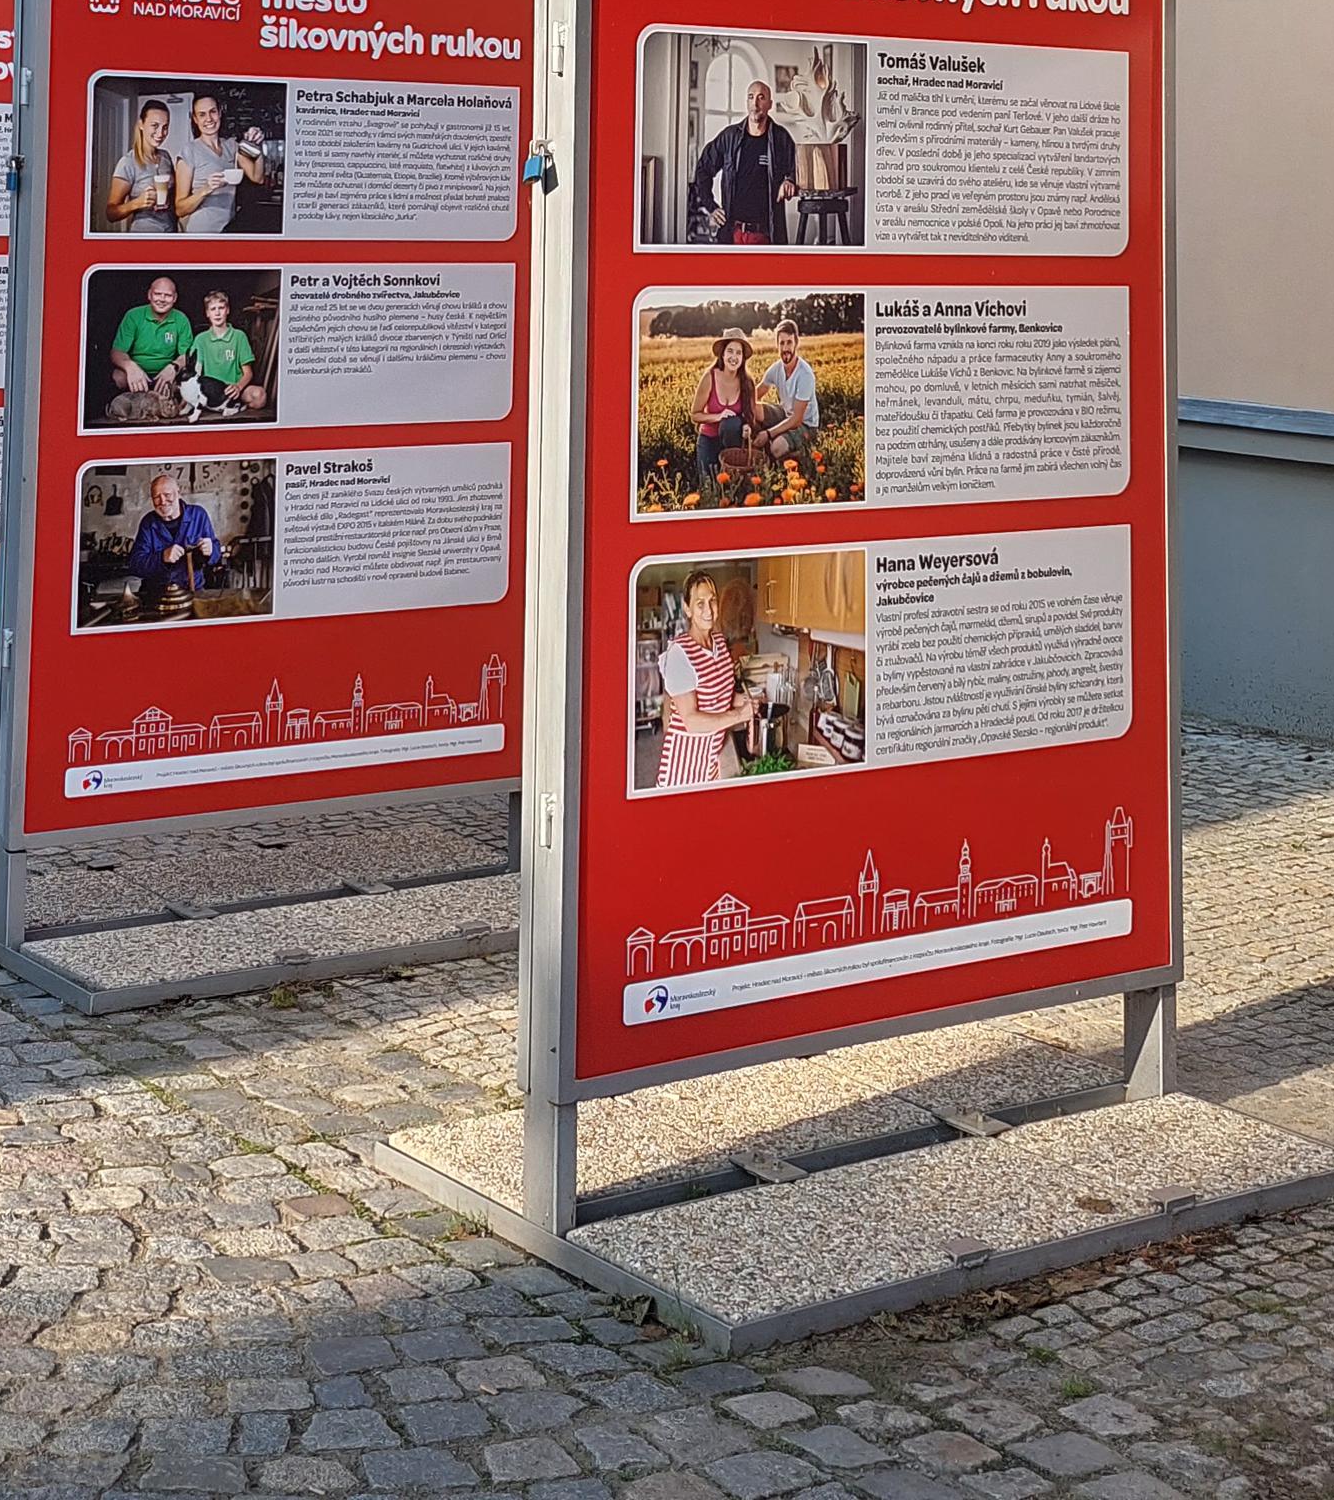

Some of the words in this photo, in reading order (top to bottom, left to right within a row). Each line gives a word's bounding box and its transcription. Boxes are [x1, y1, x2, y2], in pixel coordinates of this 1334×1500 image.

[133, 3, 167, 17] NAD
[169, 3, 241, 21] MORAVICÍ
[259, 15, 424, 60] šikovných
[431, 29, 521, 60] rukou
[877, 52, 927, 71] Tomáš
[928, 55, 986, 74] Valušek
[876, 74, 911, 88] sochař,
[912, 76, 946, 88] Hradec
[946, 78, 964, 89] nad
[965, 79, 1004, 91] Moravicí
[296, 89, 334, 103] Petra
[335, 90, 395, 108] Schabjuk
[396, 95, 405, 105] a
[406, 93, 455, 107] Marcela
[456, 95, 513, 109] Holaňová
[876, 104, 903, 115] umění
[911, 106, 940, 117] Brance
[290, 275, 320, 287] Petr
[321, 277, 330, 287] a
[331, 273, 381, 290] Vojtěch
[382, 273, 441, 287] Sonnkovi
[875, 299, 920, 318] Lukáš
[922, 304, 932, 317] a
[933, 301, 972, 317] Anna
[974, 299, 1027, 317] Víchovi
[875, 322, 943, 336] provozovatelé
[943, 322, 988, 336] bylinkové
[988, 322, 1018, 336] farmy,
[1018, 322, 1063, 334] Benkovice
[875, 354, 925, 367] společného
[926, 353, 959, 366] nápadu
[285, 461, 321, 476] Pavel
[323, 458, 374, 474] Strakoš
[285, 478, 309, 491] pasíř,
[308, 478, 340, 488] Hradec
[339, 476, 356, 486] nad
[356, 474, 391, 486] Moravicí
[876, 556, 916, 574] Hana
[918, 546, 999, 572] Weyersová
[875, 577, 916, 593] výrobce
[916, 573, 961, 591] pečených
[961, 570, 982, 587] čajů
[982, 574, 989, 583] a
[989, 567, 1020, 582] džemů
[1020, 571, 1026, 580] z
[1026, 565, 1073, 579] bobulovin,
[875, 591, 935, 607] Jakubčovice
[875, 610, 903, 624] Vlastní
